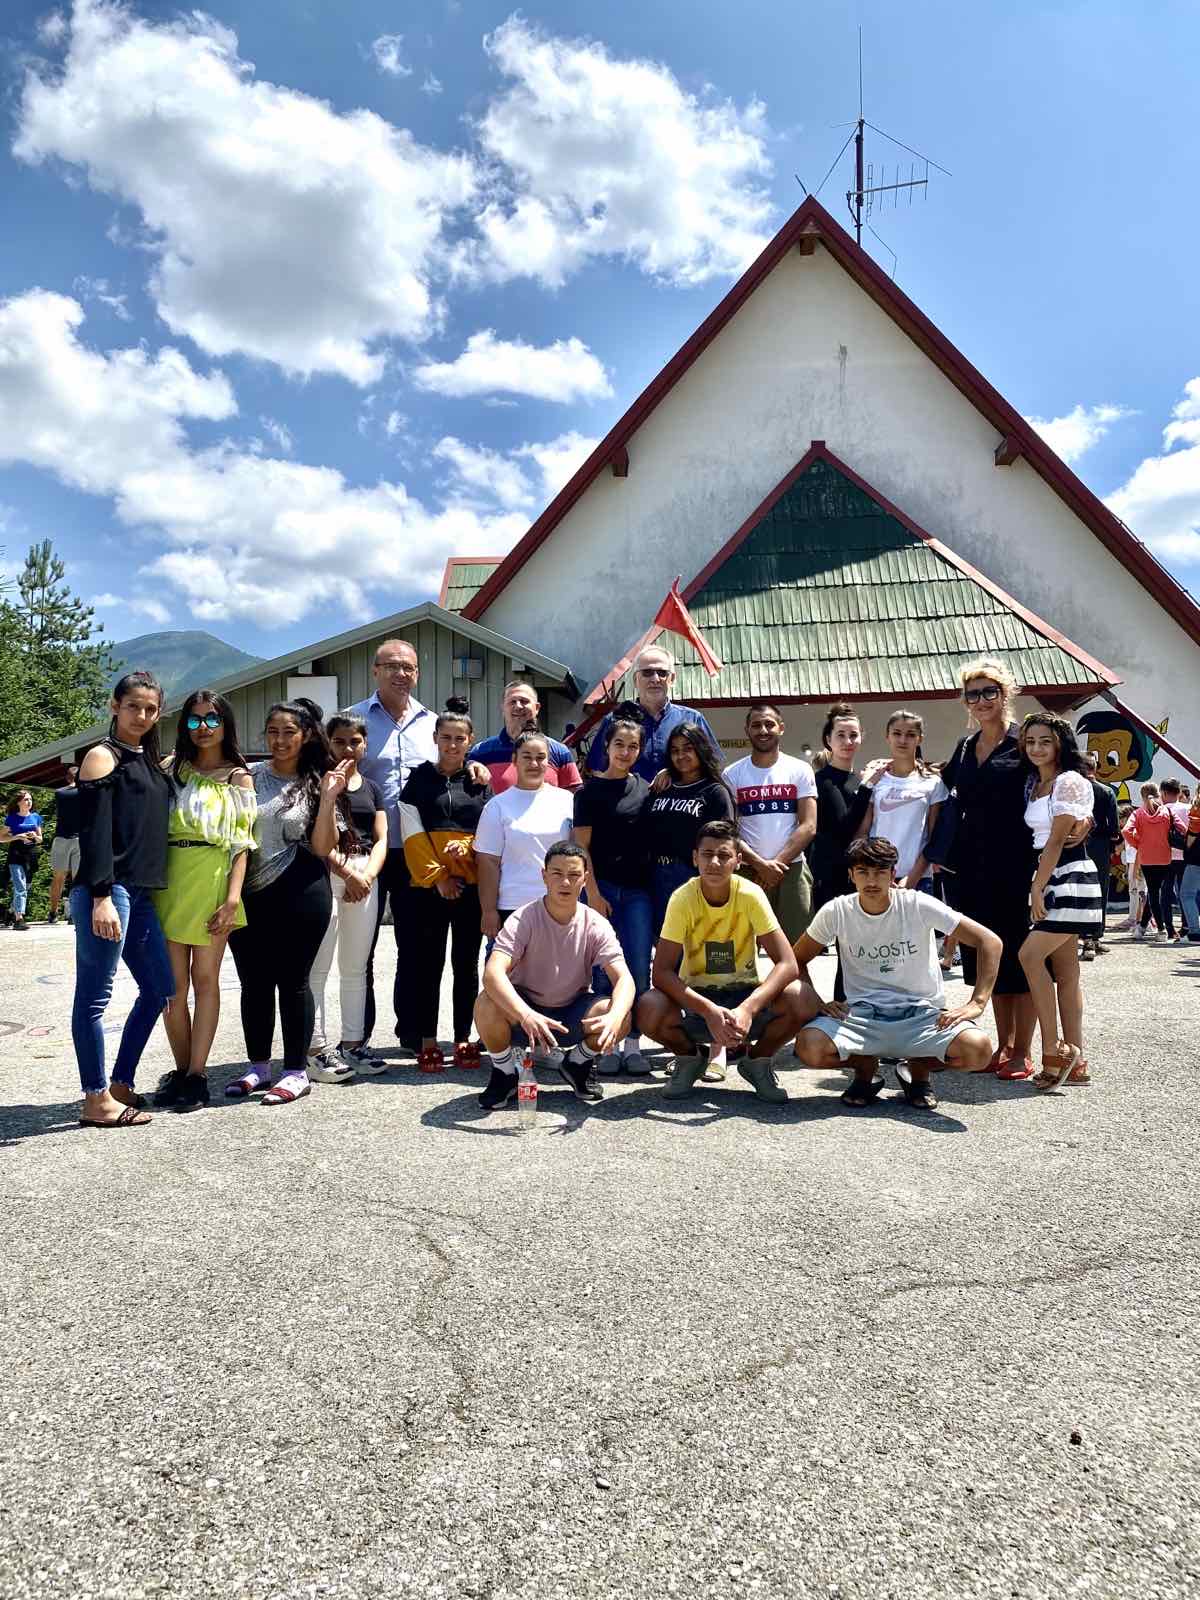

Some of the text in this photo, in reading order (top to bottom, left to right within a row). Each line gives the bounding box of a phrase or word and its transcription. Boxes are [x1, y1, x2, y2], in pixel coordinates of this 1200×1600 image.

[742, 787, 791, 800] TOMMY
[670, 798, 704, 817] YORK
[749, 801, 790, 813] 1985
[848, 940, 918, 959] LACOSTE
